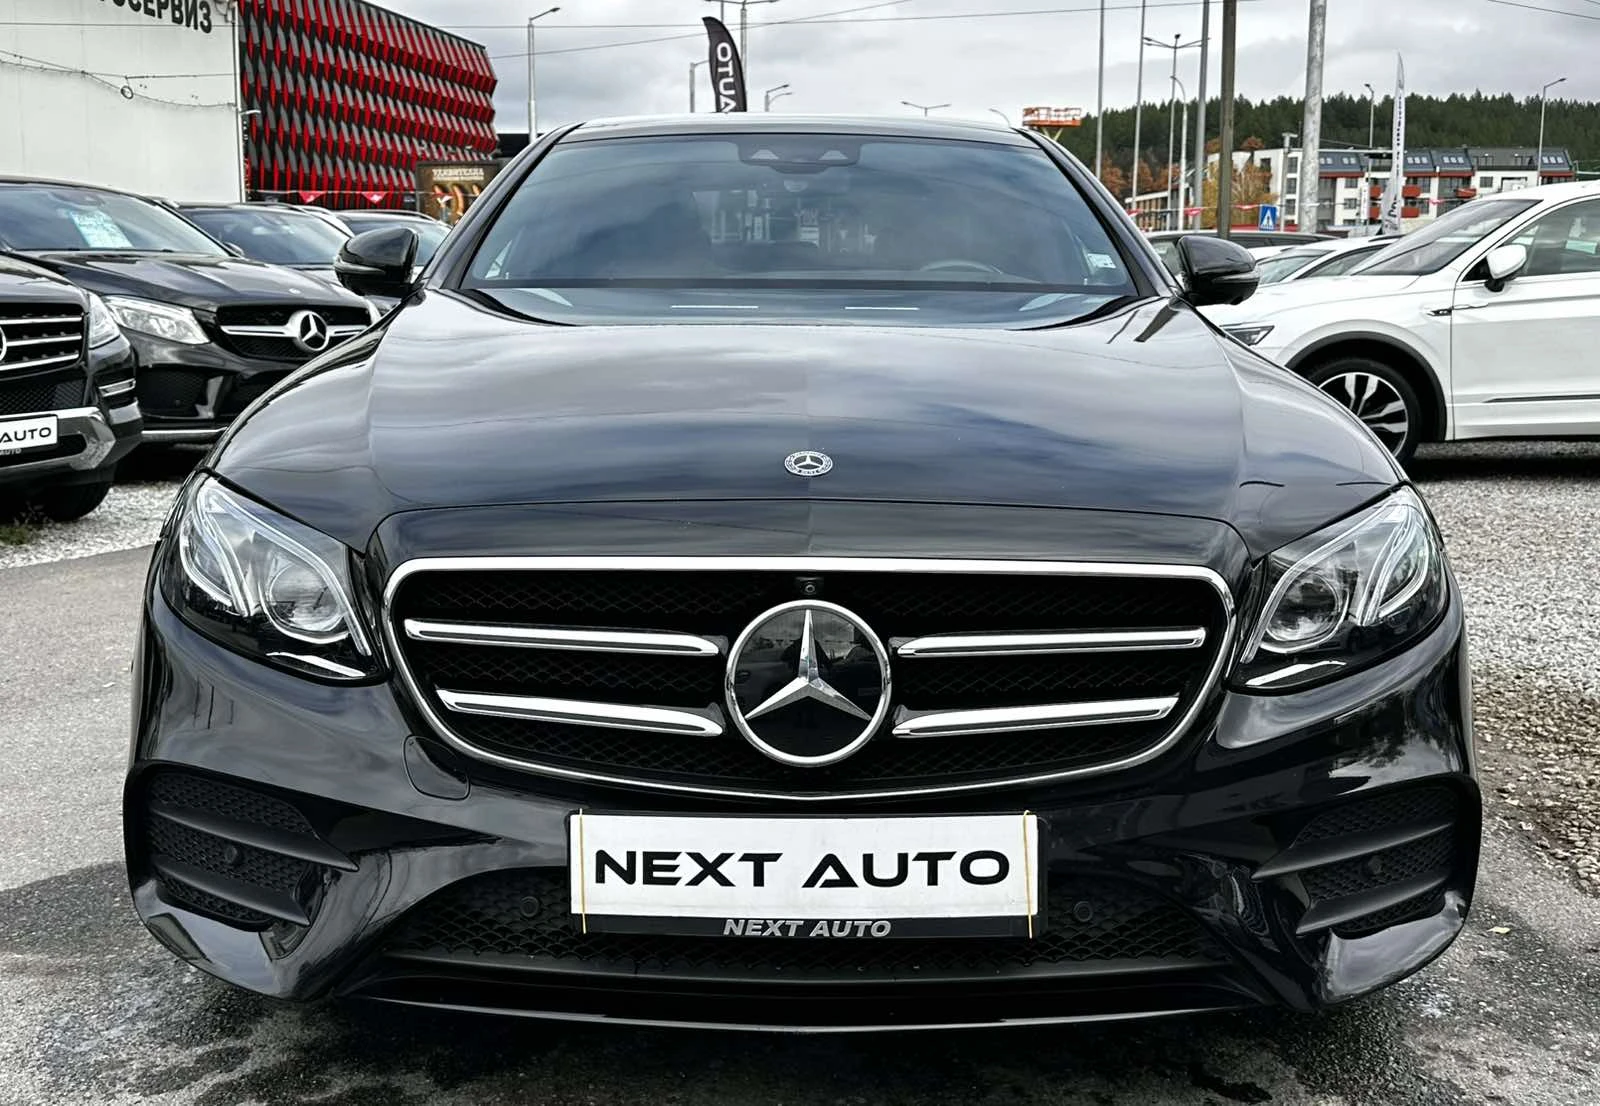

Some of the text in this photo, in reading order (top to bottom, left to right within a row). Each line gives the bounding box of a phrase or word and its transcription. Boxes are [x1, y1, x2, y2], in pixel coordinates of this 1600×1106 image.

[0, 427, 51, 443] AUTO
[595, 849, 1010, 888] NEXT AUTO
[723, 919, 892, 937] NEXT AUTO
